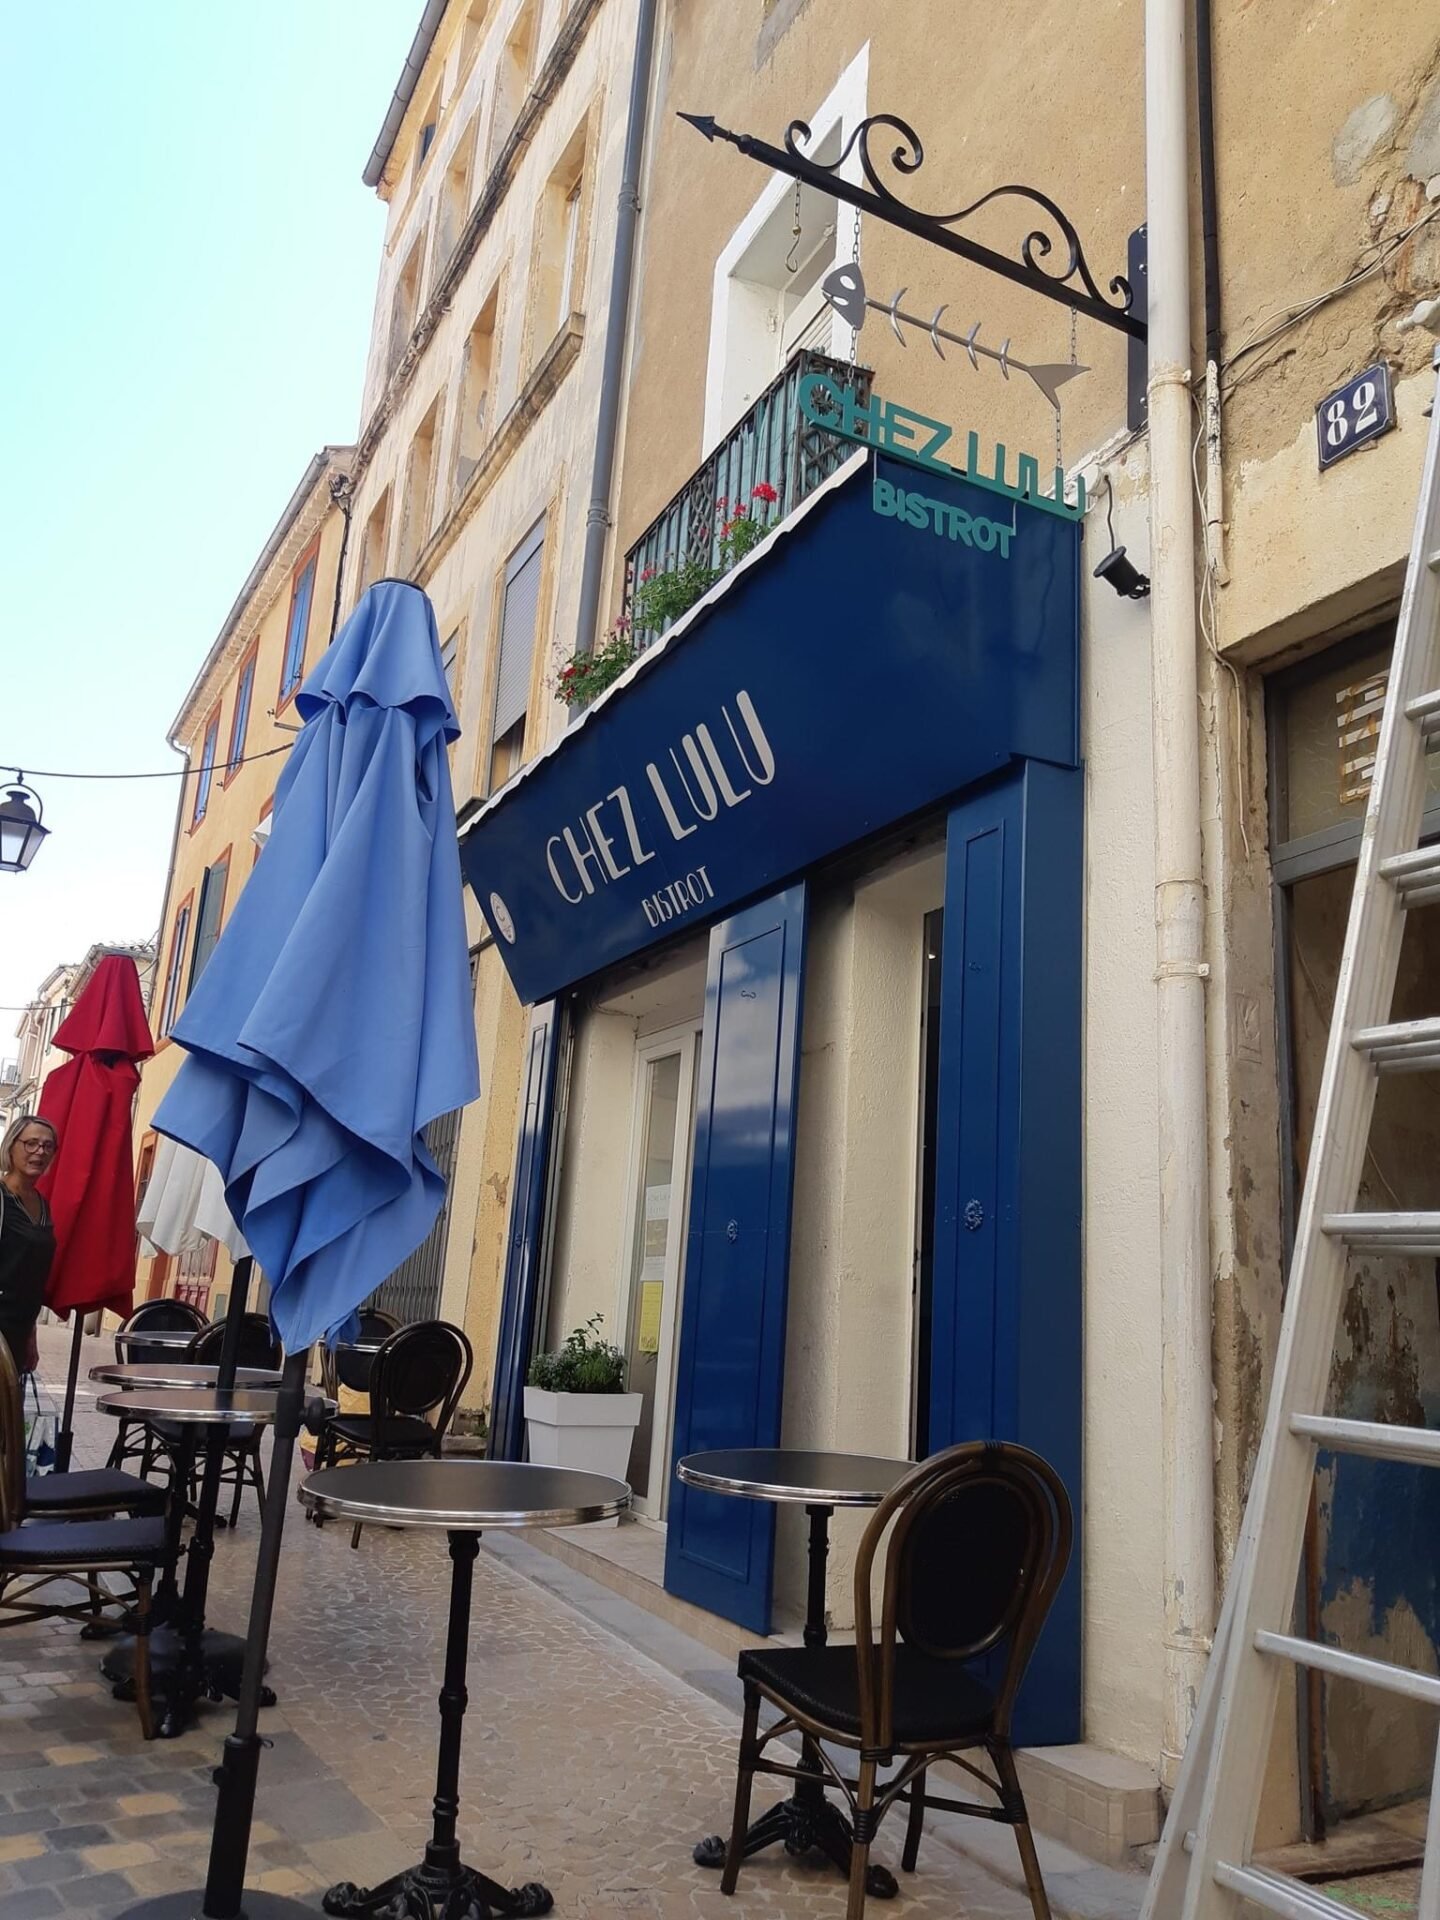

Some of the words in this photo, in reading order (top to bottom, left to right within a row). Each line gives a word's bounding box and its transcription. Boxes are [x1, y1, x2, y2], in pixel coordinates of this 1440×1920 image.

[800, 373, 953, 473] CHEZ
[966, 430, 1086, 522] LULU
[1327, 381, 1378, 446] 82
[872, 479, 1015, 559] BISTROT
[546, 785, 656, 904] CHEZ
[646, 689, 775, 841] LULU
[641, 865, 715, 928] BISTROT
